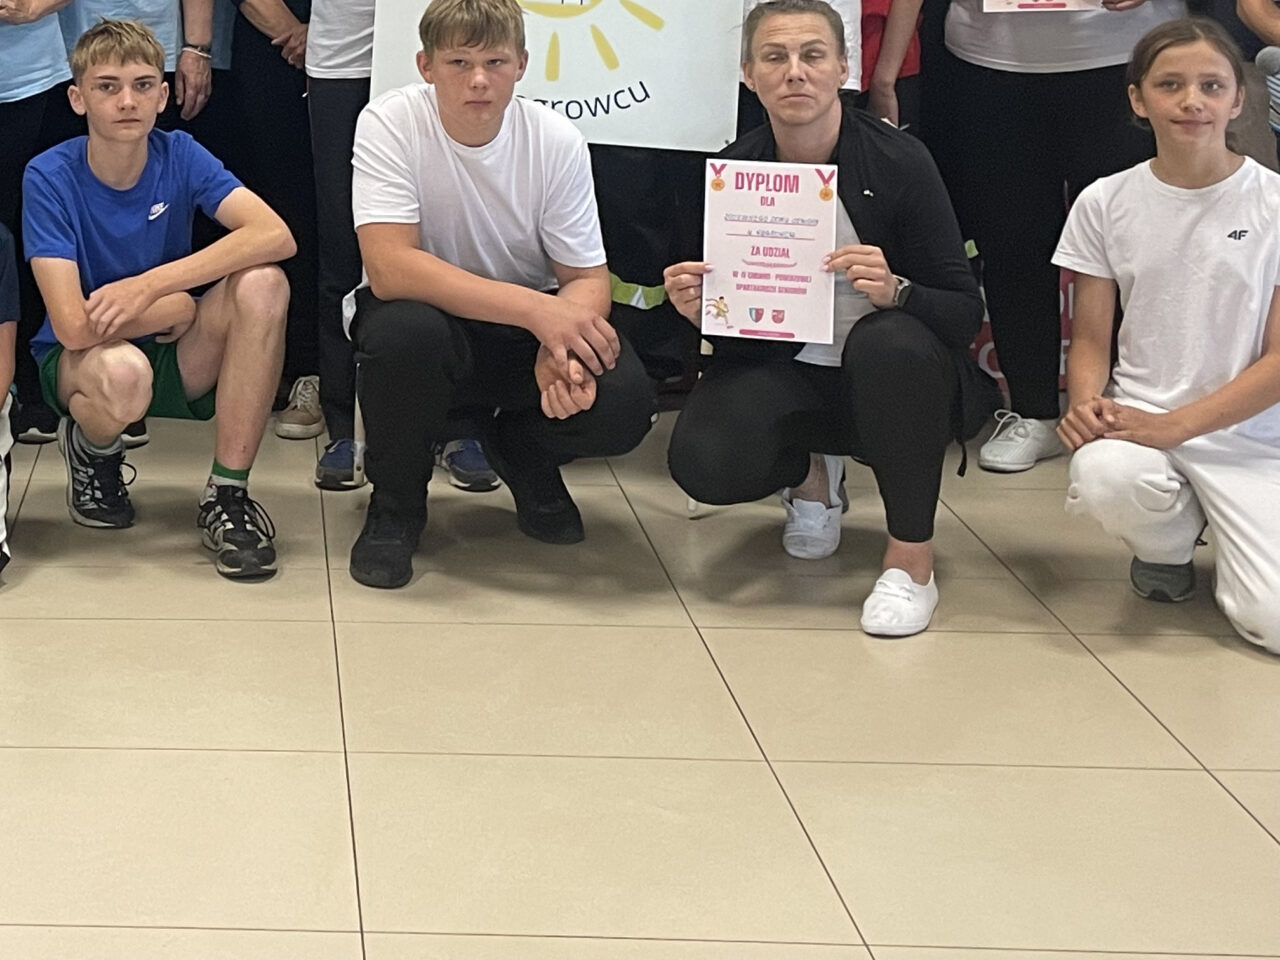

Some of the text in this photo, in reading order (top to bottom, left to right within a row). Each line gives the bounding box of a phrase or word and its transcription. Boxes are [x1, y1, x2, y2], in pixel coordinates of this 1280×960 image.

[735, 172, 799, 193] DYPLOM
[760, 196, 775, 207] DLA
[1227, 230, 1249, 241] 4F
[750, 245, 790, 259] ZA UDZIAŁ
